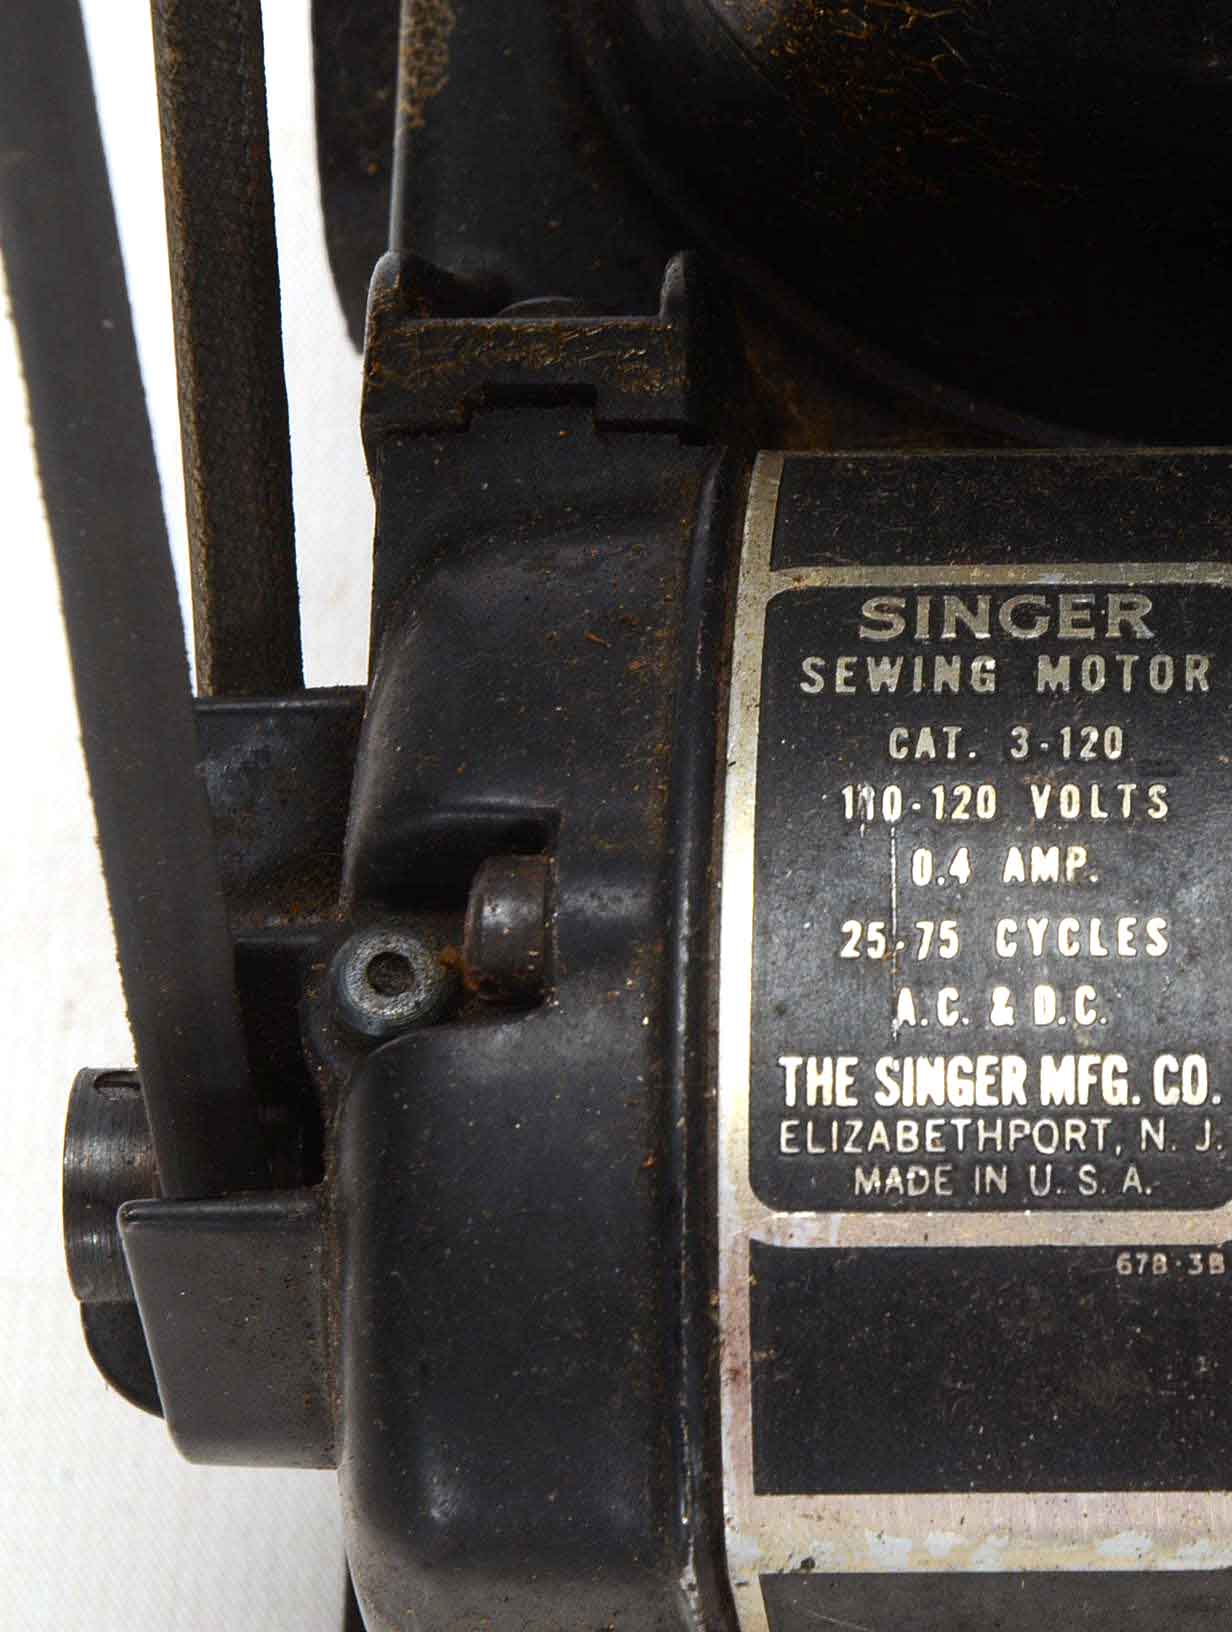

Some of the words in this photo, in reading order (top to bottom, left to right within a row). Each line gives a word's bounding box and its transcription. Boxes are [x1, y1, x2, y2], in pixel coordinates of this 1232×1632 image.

[860, 594, 1155, 640] SINGER
[799, 656, 997, 694] SEWING
[1036, 654, 1211, 694] MOTOR
[889, 727, 977, 760] CAT.
[841, 785, 997, 821] 110-120
[1030, 784, 1170, 820] VOLTS
[911, 847, 971, 886] 0.4
[1002, 846, 1099, 883] AMP.
[995, 917, 1169, 958] CYCLES
[892, 986, 970, 1026] A.C.
[989, 986, 1015, 1026] &
[1033, 984, 1108, 1026] D.C.
[778, 1056, 859, 1106] THE
[874, 1055, 1028, 1107] SINGER
[1039, 1054, 1141, 1107] MFG.
[1153, 1055, 1222, 1106] CO.
[779, 1119, 1125, 1156] ELIZABETHPORT,
[854, 1165, 953, 1196] MADE
[974, 1164, 1007, 1195] IN
